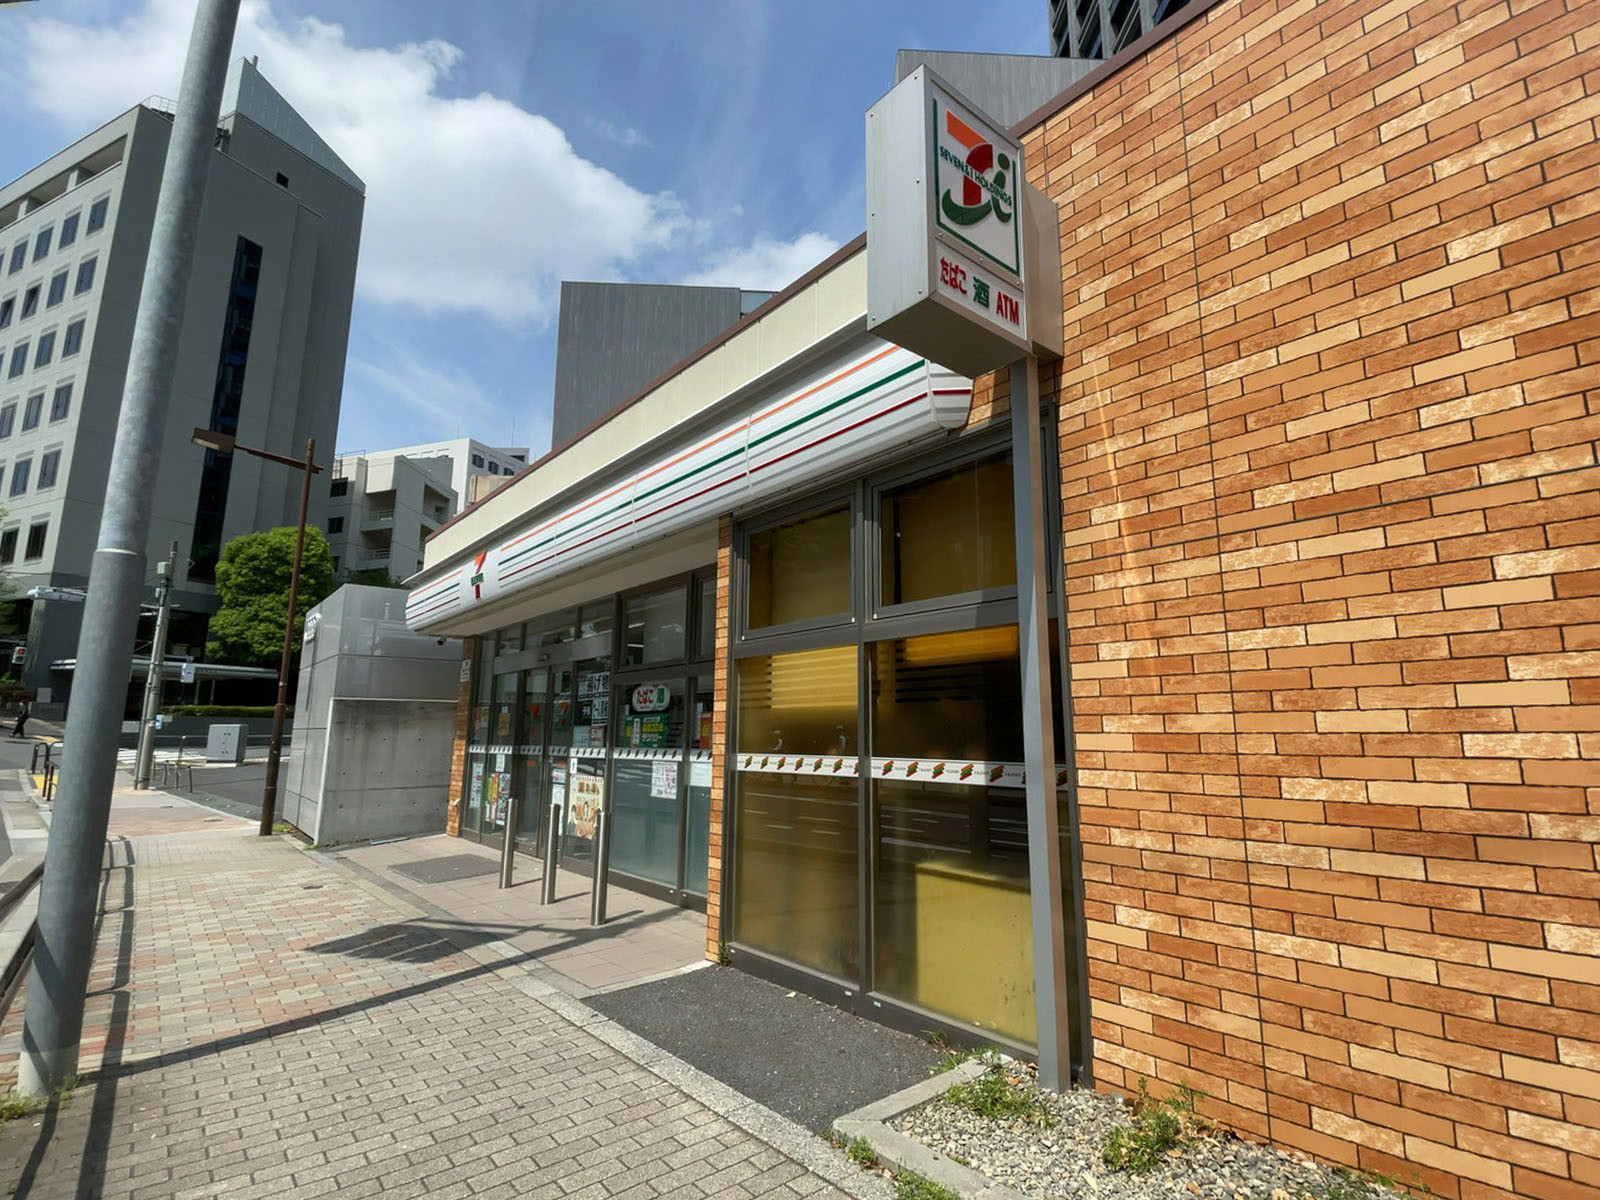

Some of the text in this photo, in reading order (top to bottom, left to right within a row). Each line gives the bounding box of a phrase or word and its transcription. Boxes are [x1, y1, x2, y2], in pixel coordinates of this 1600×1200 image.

[975, 171, 1012, 207] HOLDINGS
[940, 257, 1019, 326] たばこ 酒 ATM
